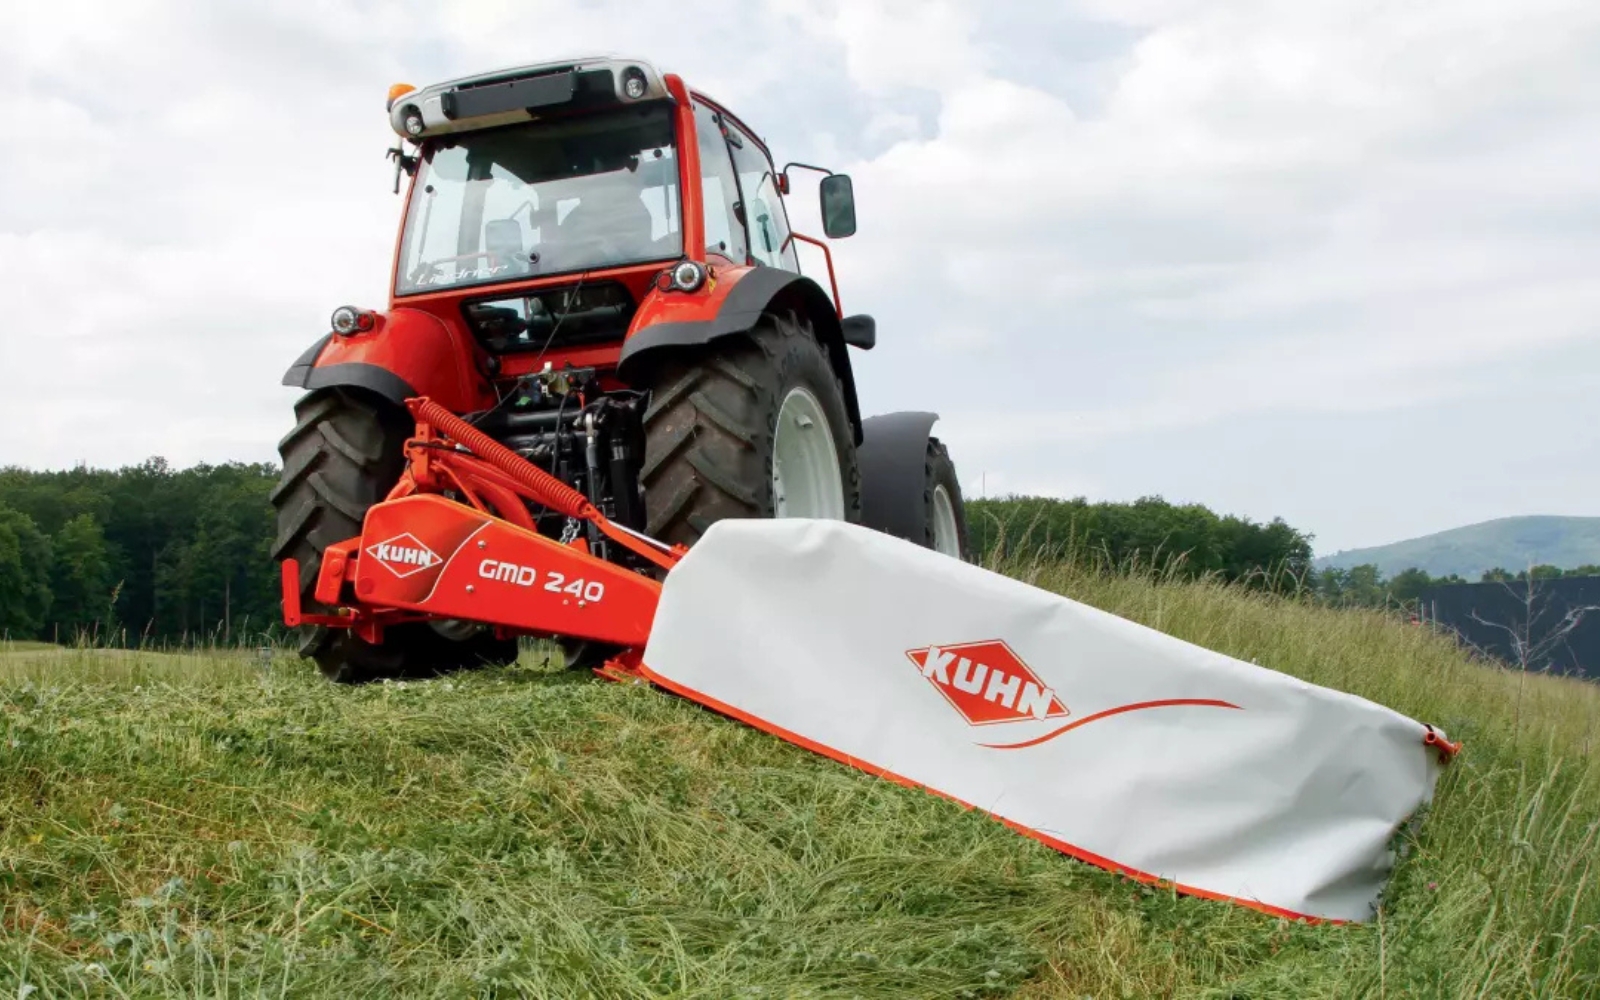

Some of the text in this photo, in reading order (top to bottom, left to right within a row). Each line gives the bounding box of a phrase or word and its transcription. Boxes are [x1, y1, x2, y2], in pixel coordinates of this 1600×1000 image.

[376, 544, 432, 567] KUHN
[478, 559, 604, 602] GMD 240
[921, 645, 1055, 721] KUHN
